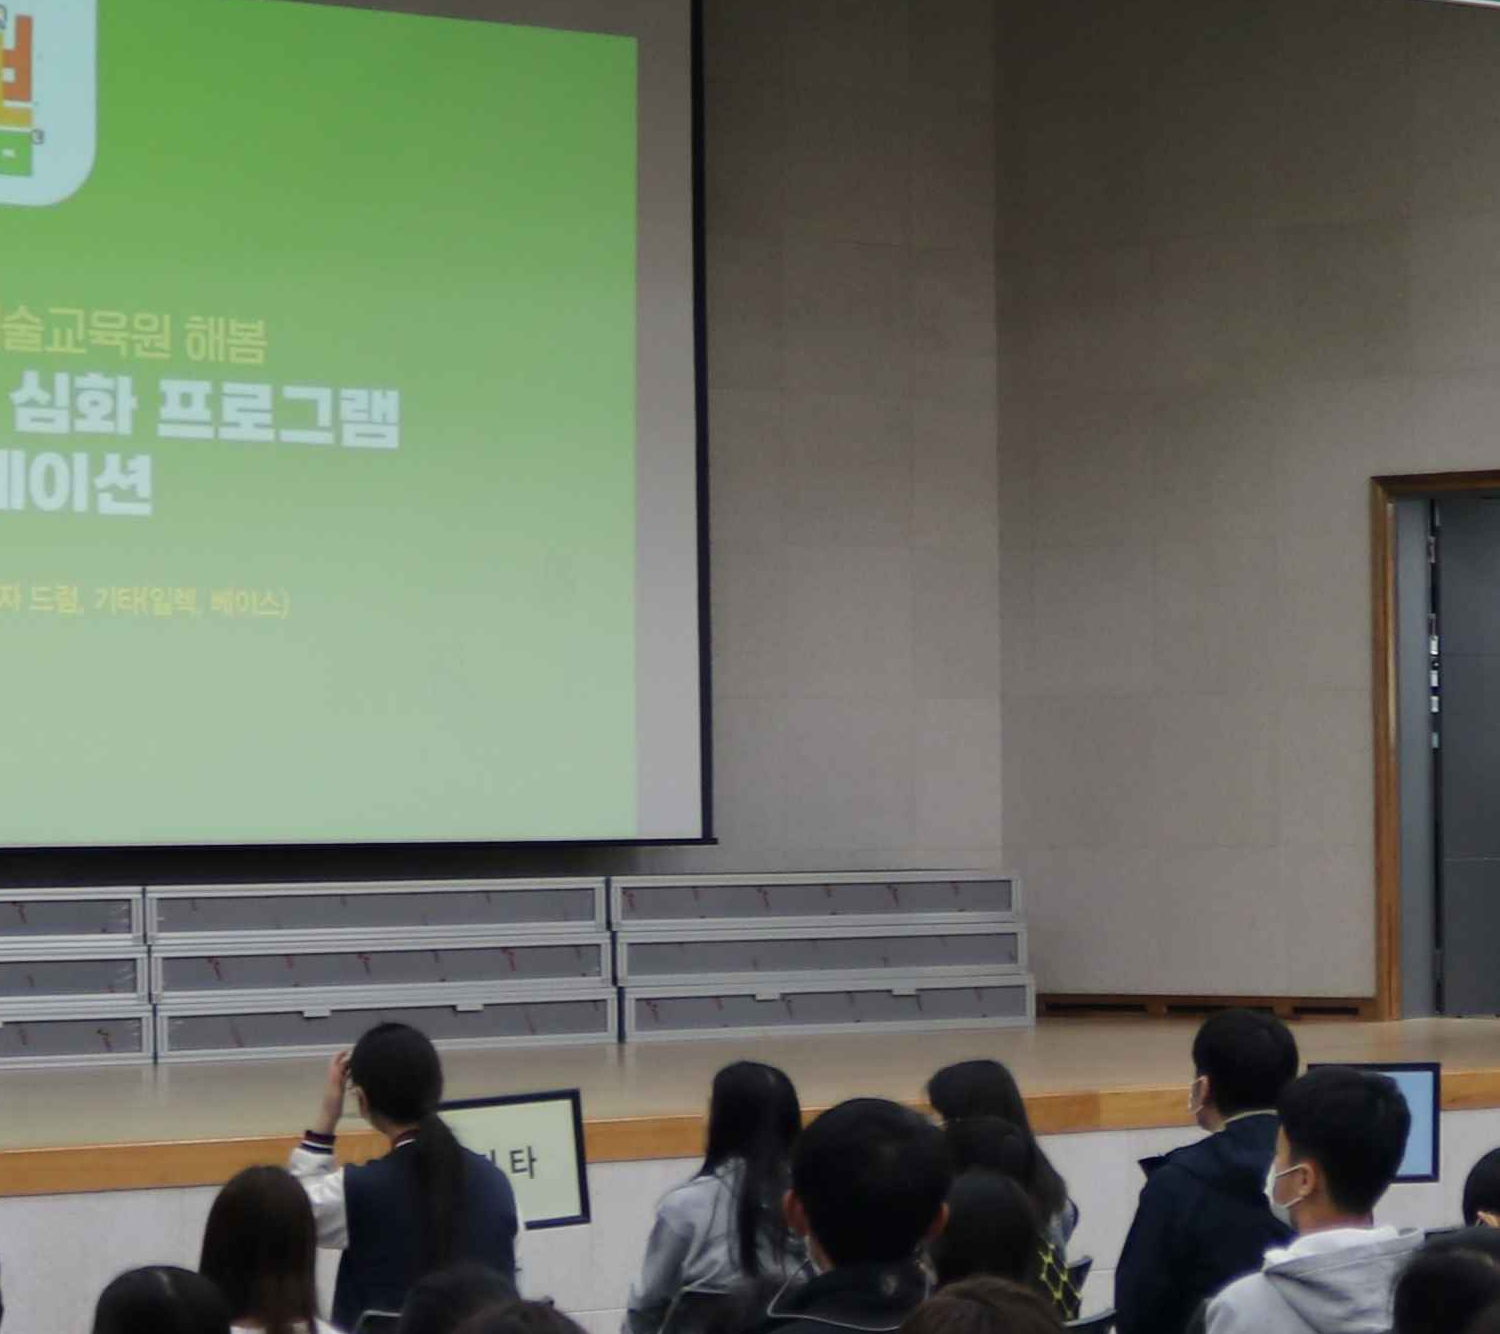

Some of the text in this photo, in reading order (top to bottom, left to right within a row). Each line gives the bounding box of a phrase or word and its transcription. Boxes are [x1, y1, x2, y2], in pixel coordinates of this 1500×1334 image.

[185, 315, 269, 365] 해봄
[9, 369, 139, 437] 심화
[156, 378, 401, 450] 프로그램
